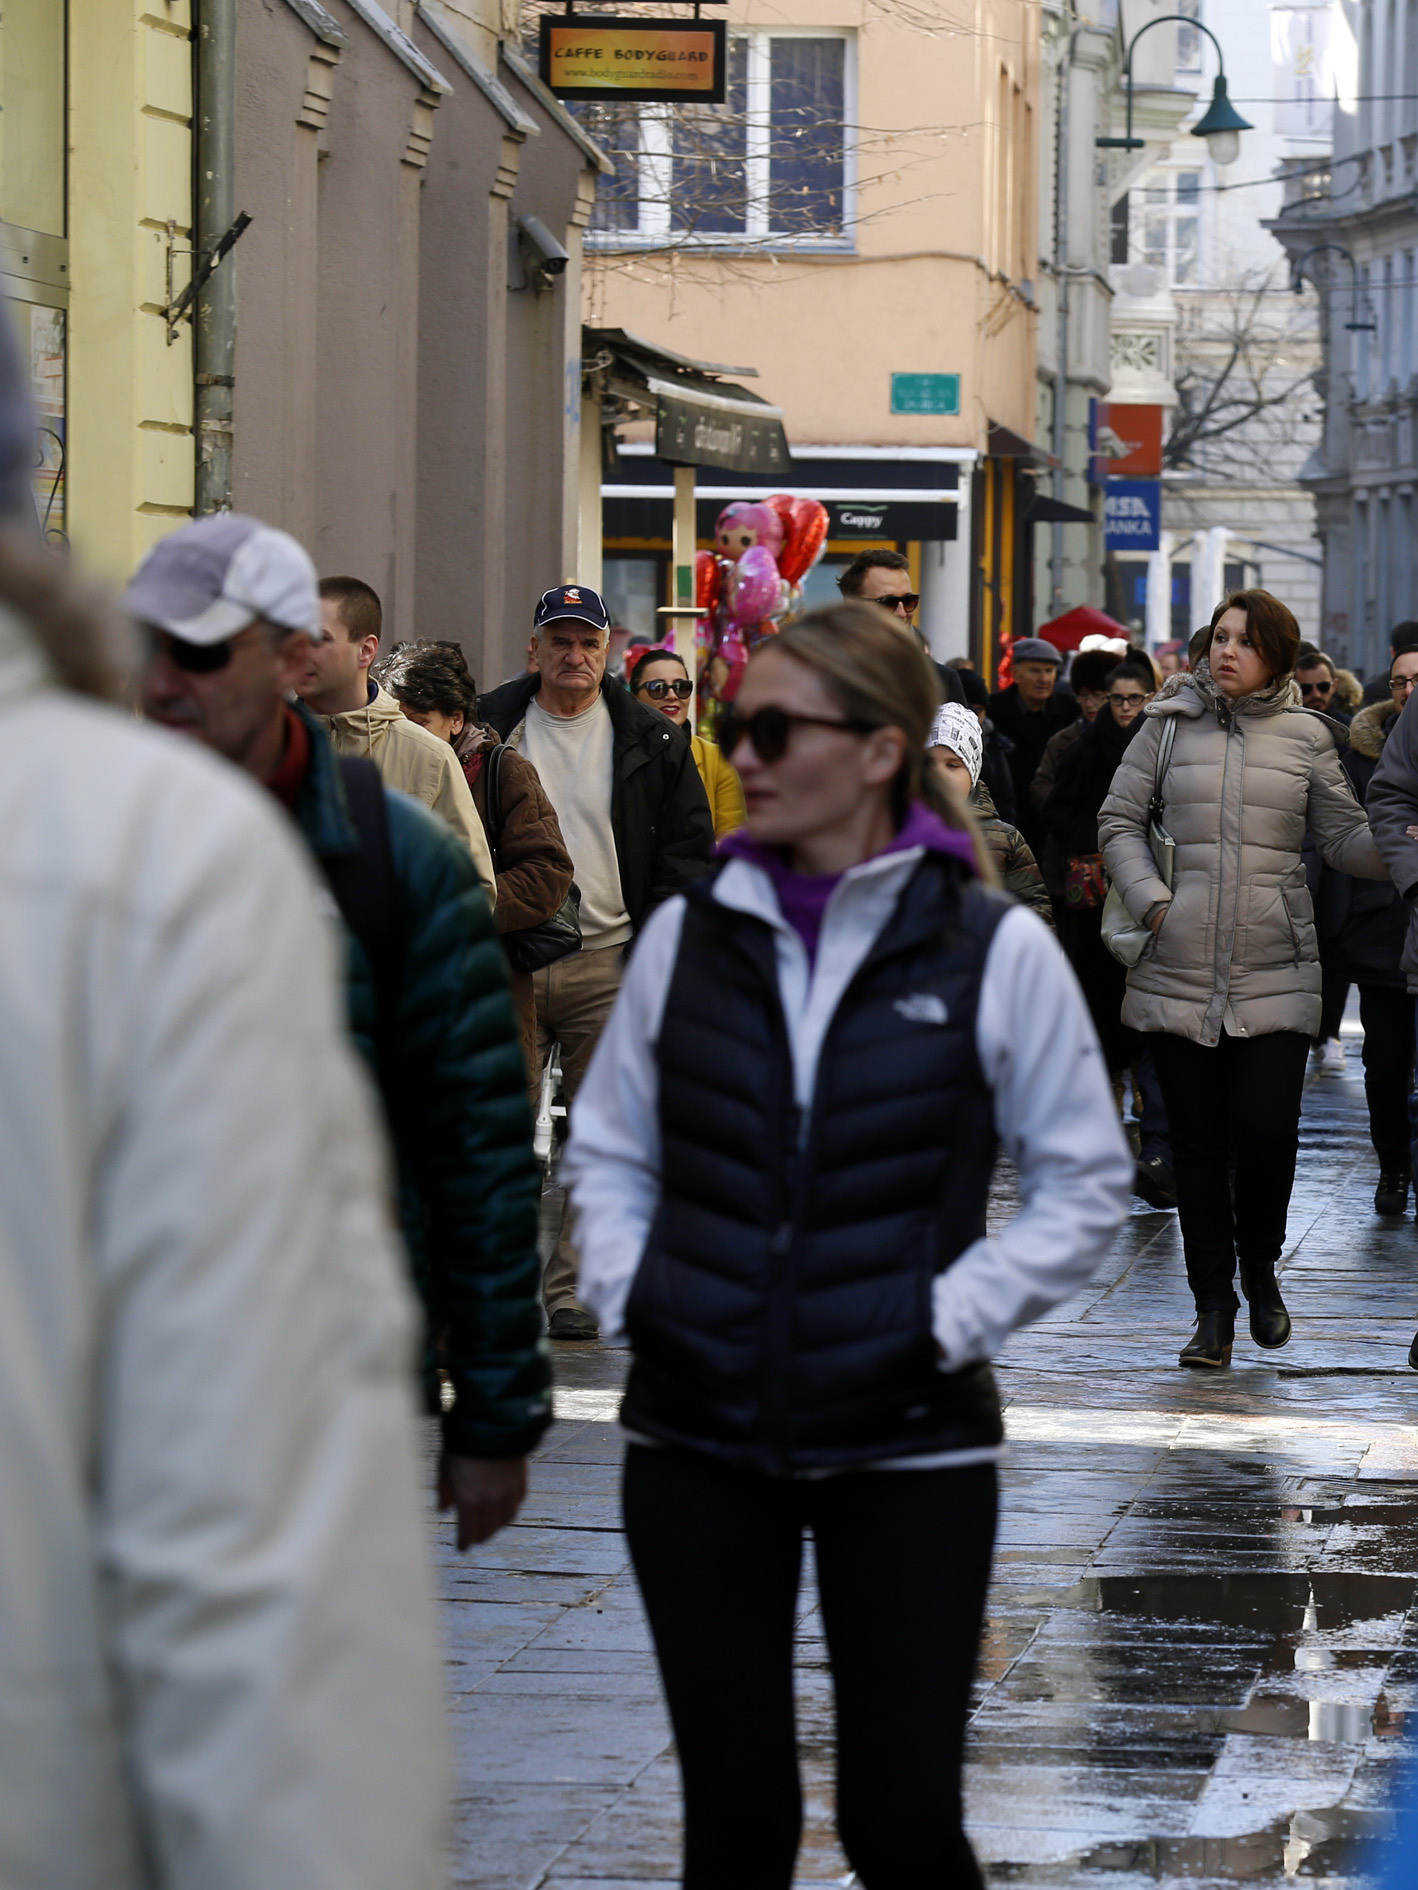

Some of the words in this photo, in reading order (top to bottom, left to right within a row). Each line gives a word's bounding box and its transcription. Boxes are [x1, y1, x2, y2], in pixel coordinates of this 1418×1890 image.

[554, 48, 603, 59] CAFFE
[614, 49, 708, 62] BODYGUARD
[564, 67, 697, 80] www.bodyguardradio.com
[840, 512, 883, 528] Cappy
[1104, 519, 1152, 535] ANKA
